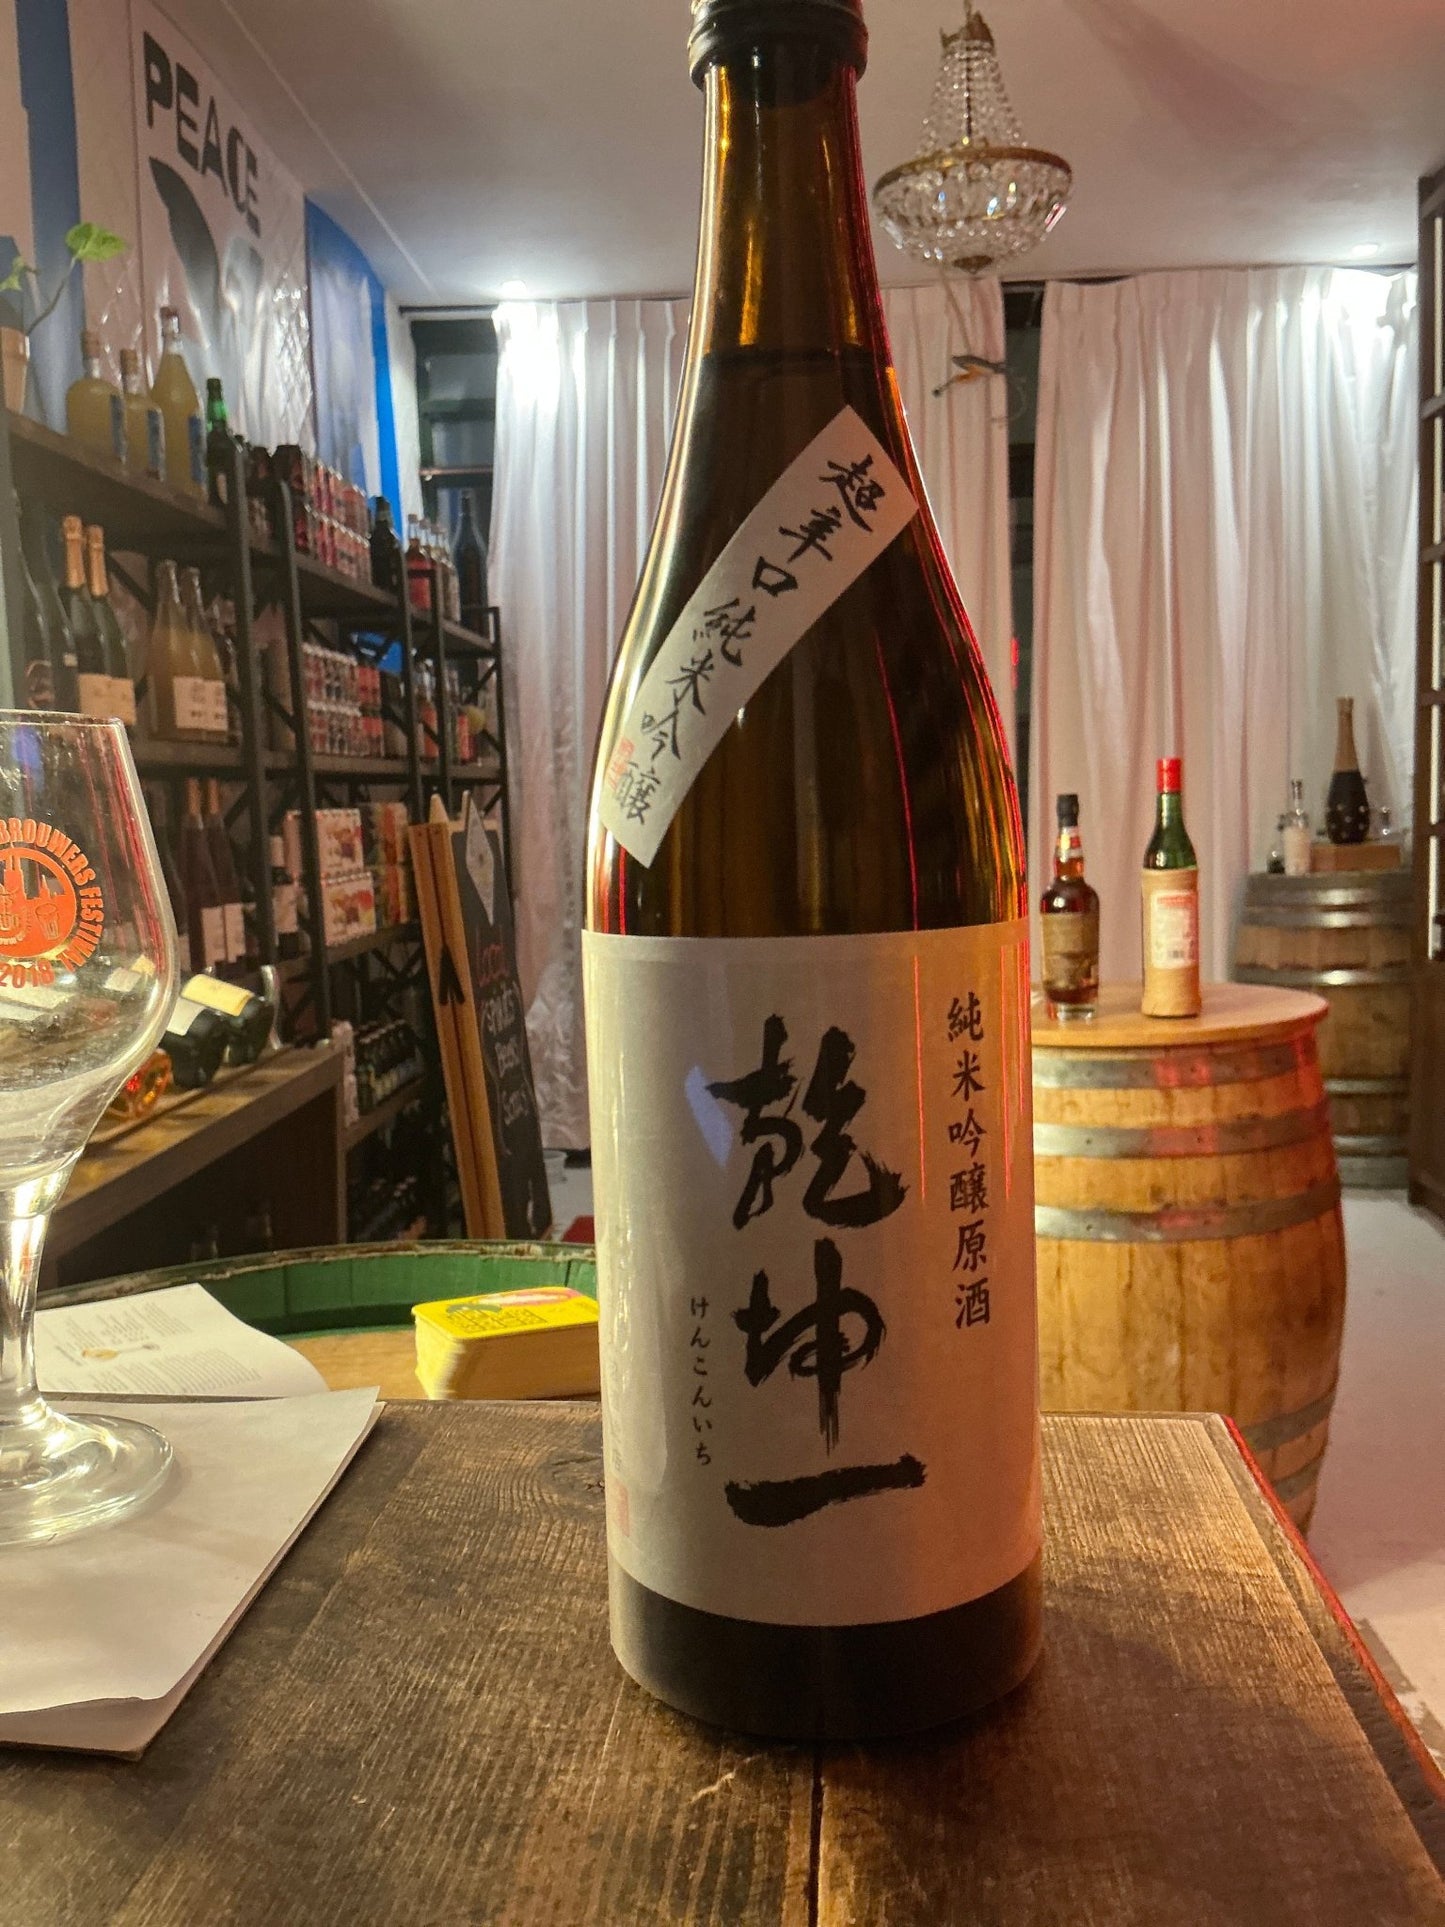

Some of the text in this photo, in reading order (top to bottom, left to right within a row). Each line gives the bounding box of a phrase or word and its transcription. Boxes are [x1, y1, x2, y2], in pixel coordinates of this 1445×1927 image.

[143, 31, 260, 238] PEACE
[0, 958, 55, 989] 2018
[56, 886, 104, 973] FESTIVAL
[946, 991, 990, 1330] 純米吟醸原酒
[706, 1013, 926, 1528] 乾坤一
[689, 1296, 713, 1467] けんこんいち
